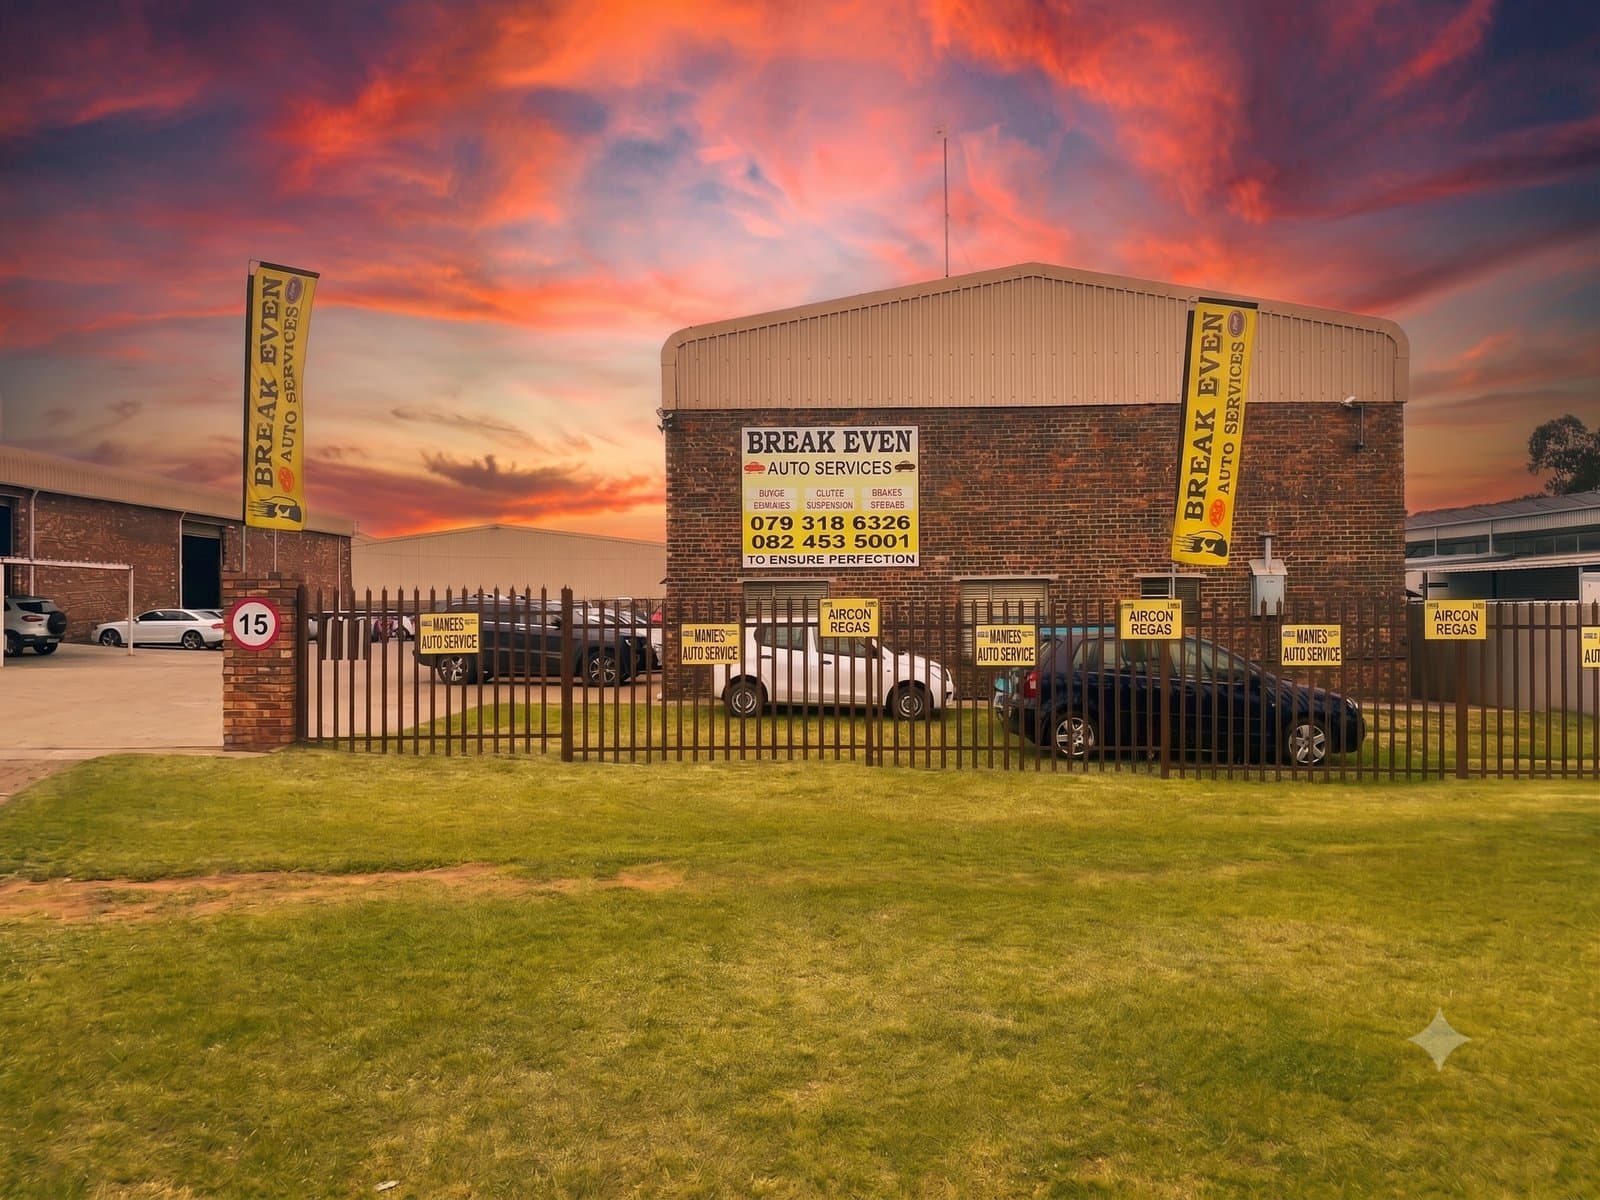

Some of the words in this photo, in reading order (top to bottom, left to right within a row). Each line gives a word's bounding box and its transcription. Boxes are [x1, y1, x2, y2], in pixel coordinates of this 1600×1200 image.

[260, 276, 283, 366] EVEN
[283, 305, 299, 404] SERVICES
[1197, 311, 1224, 397] EVEN
[1224, 341, 1245, 435] SERVICES
[254, 377, 279, 488] BREAK
[280, 411, 297, 463] AUTO
[747, 431, 836, 454] BREAK
[843, 430, 912, 453] EVEN
[768, 461, 810, 475] AUTO
[815, 461, 892, 475] SERVICES
[1184, 408, 1216, 521] BREAK
[1217, 442, 1235, 495] AUTO
[806, 501, 854, 510] SUSPENSION
[750, 515, 793, 531] 079
[801, 515, 845, 530] 318
[852, 515, 911, 530] 6326
[752, 534, 794, 549] 082
[802, 534, 846, 549] 453
[854, 534, 909, 549] 5001
[748, 555, 766, 565] TO
[769, 555, 824, 564] ENSURE
[829, 554, 915, 564] PERFECTION
[828, 608, 872, 620] AIRCON
[1129, 610, 1173, 622] AIRCON
[1433, 610, 1479, 622] AIRCON
[239, 613, 268, 635] 15
[830, 621, 870, 633] REGAS
[1131, 623, 1172, 635] REGAS
[1436, 623, 1477, 635] REGAS
[422, 635, 442, 649] AUTO
[444, 634, 477, 649] SERVICE
[683, 646, 703, 660] AUTO
[705, 646, 738, 660] SERVICE
[978, 647, 999, 661] AUTO
[1000, 647, 1034, 661] SERVICE
[1283, 647, 1305, 661] AUTO
[1307, 646, 1340, 661] SERVICE
